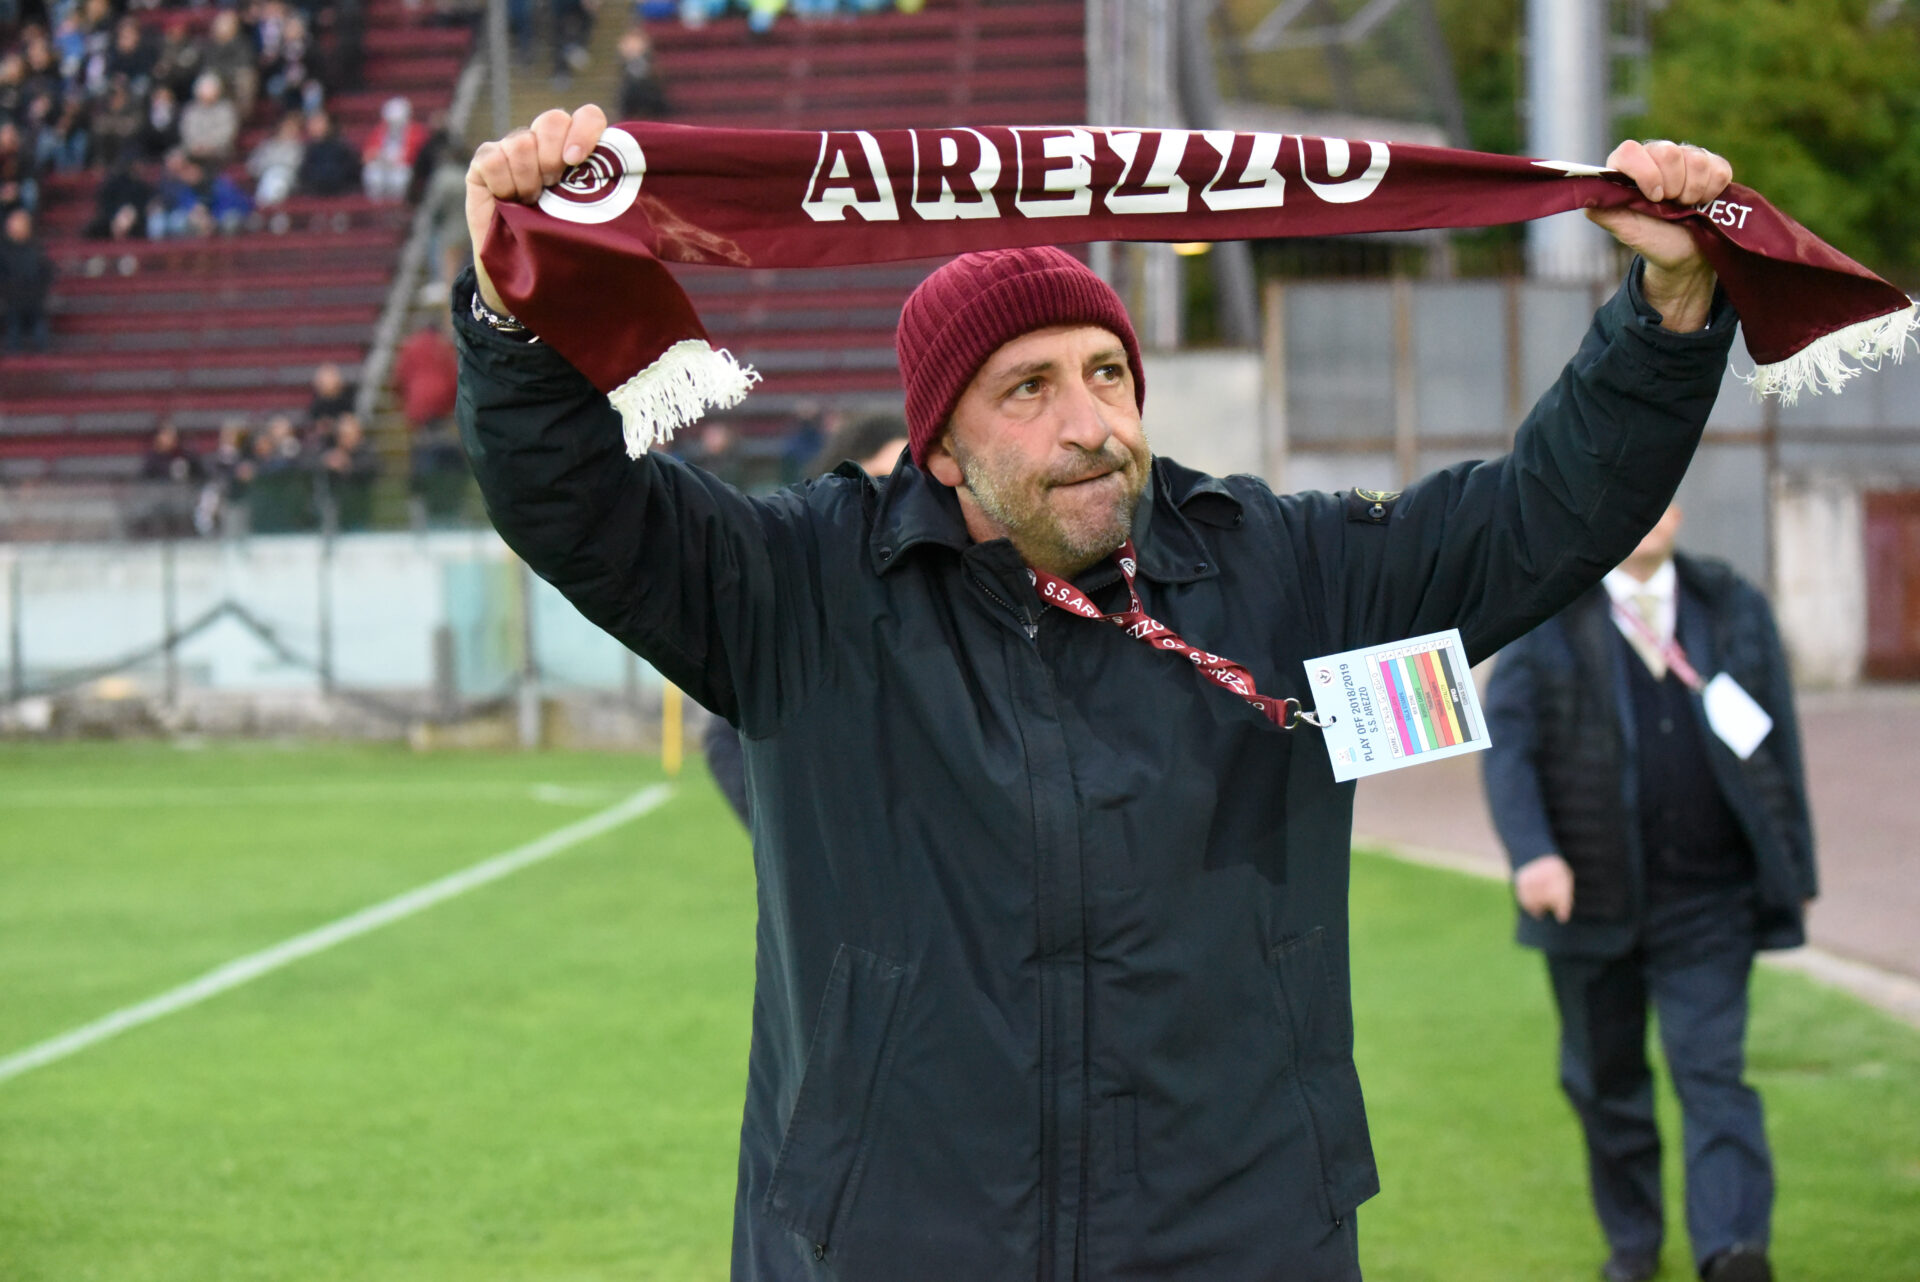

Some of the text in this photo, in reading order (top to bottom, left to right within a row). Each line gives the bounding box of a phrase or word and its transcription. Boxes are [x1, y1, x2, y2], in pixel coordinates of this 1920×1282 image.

[802, 127, 1390, 221] AREZZO
[1044, 582, 1100, 618] S.S.AR
[1339, 663, 1374, 761] PLAY OFF 2018/2019
[1357, 686, 1378, 733] S.S. AREZZO
